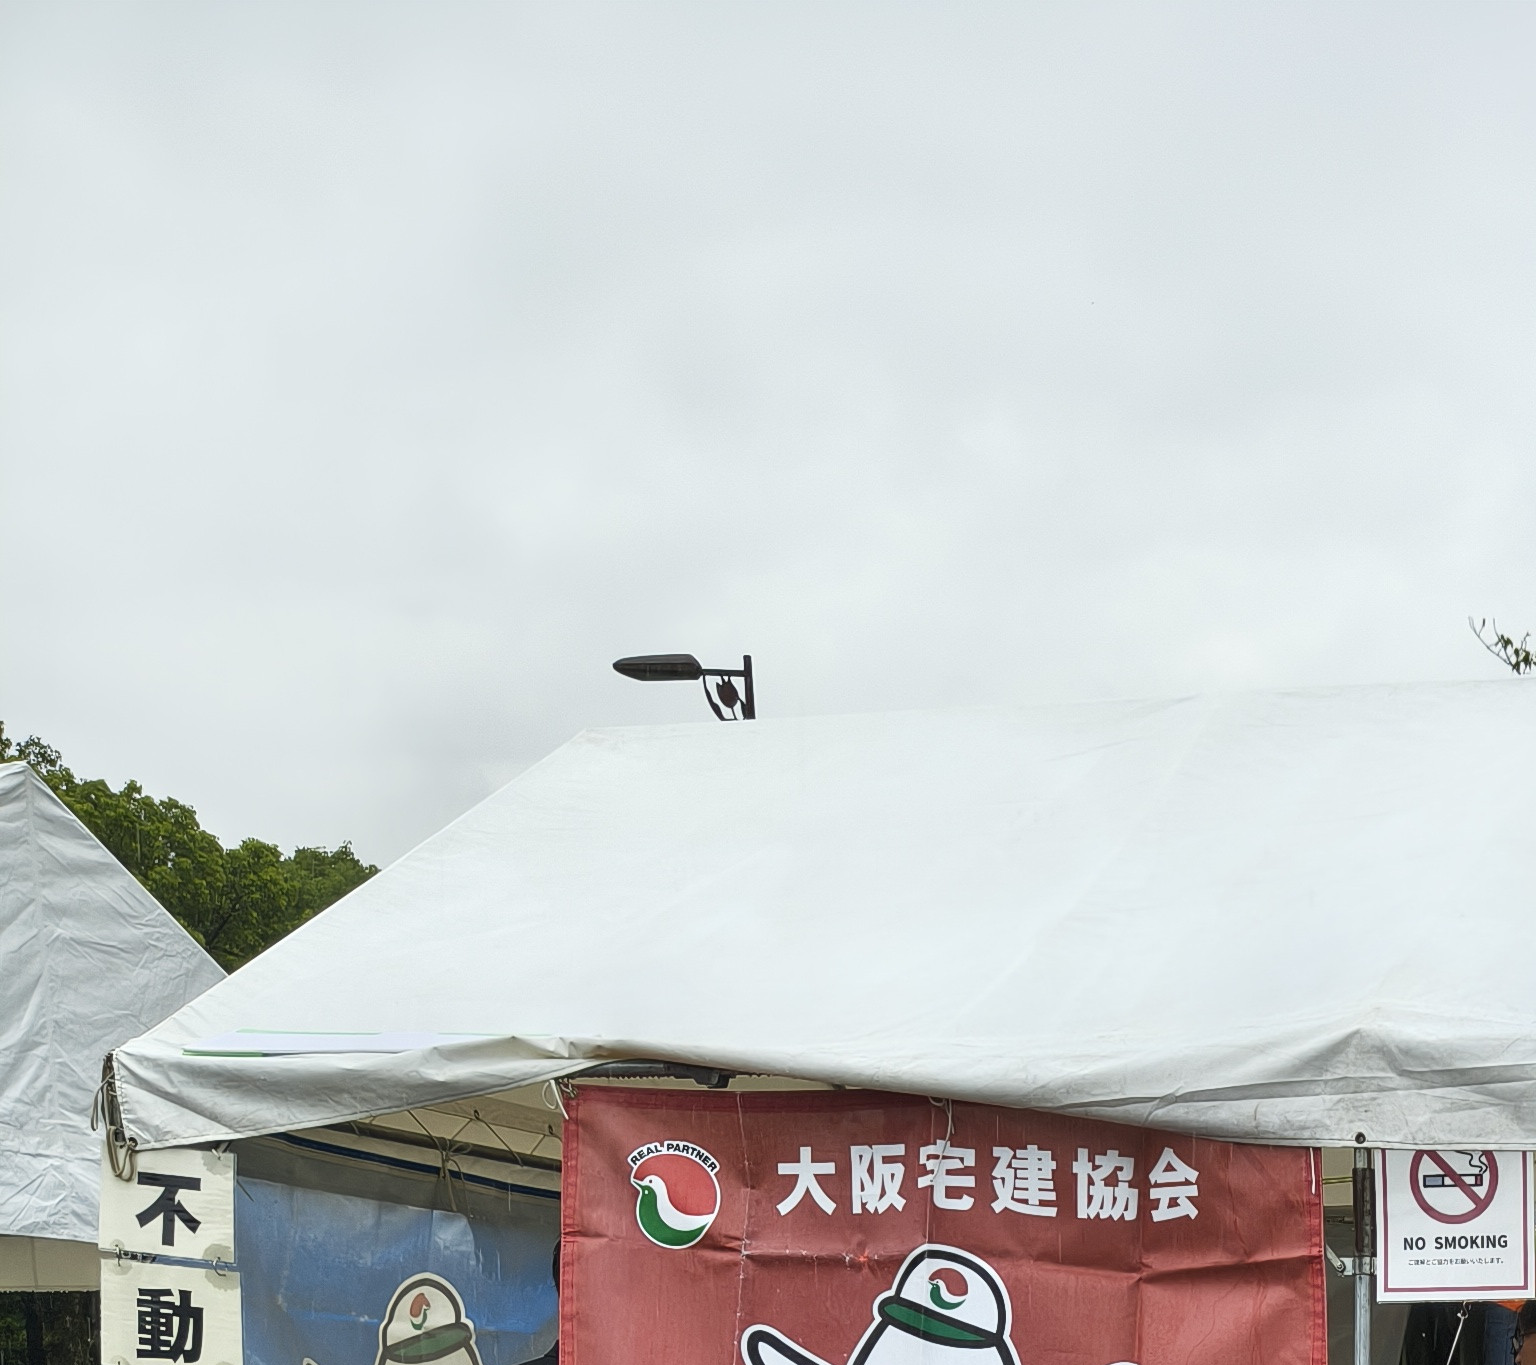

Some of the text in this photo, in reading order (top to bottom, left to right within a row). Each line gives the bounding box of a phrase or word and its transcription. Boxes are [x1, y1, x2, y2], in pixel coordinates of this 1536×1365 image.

[630, 1143, 718, 1172] REAL PARTNER
[776, 1139, 1200, 1222] 大阪宅建協会
[1403, 1234, 1508, 1251] NO SMOKING
